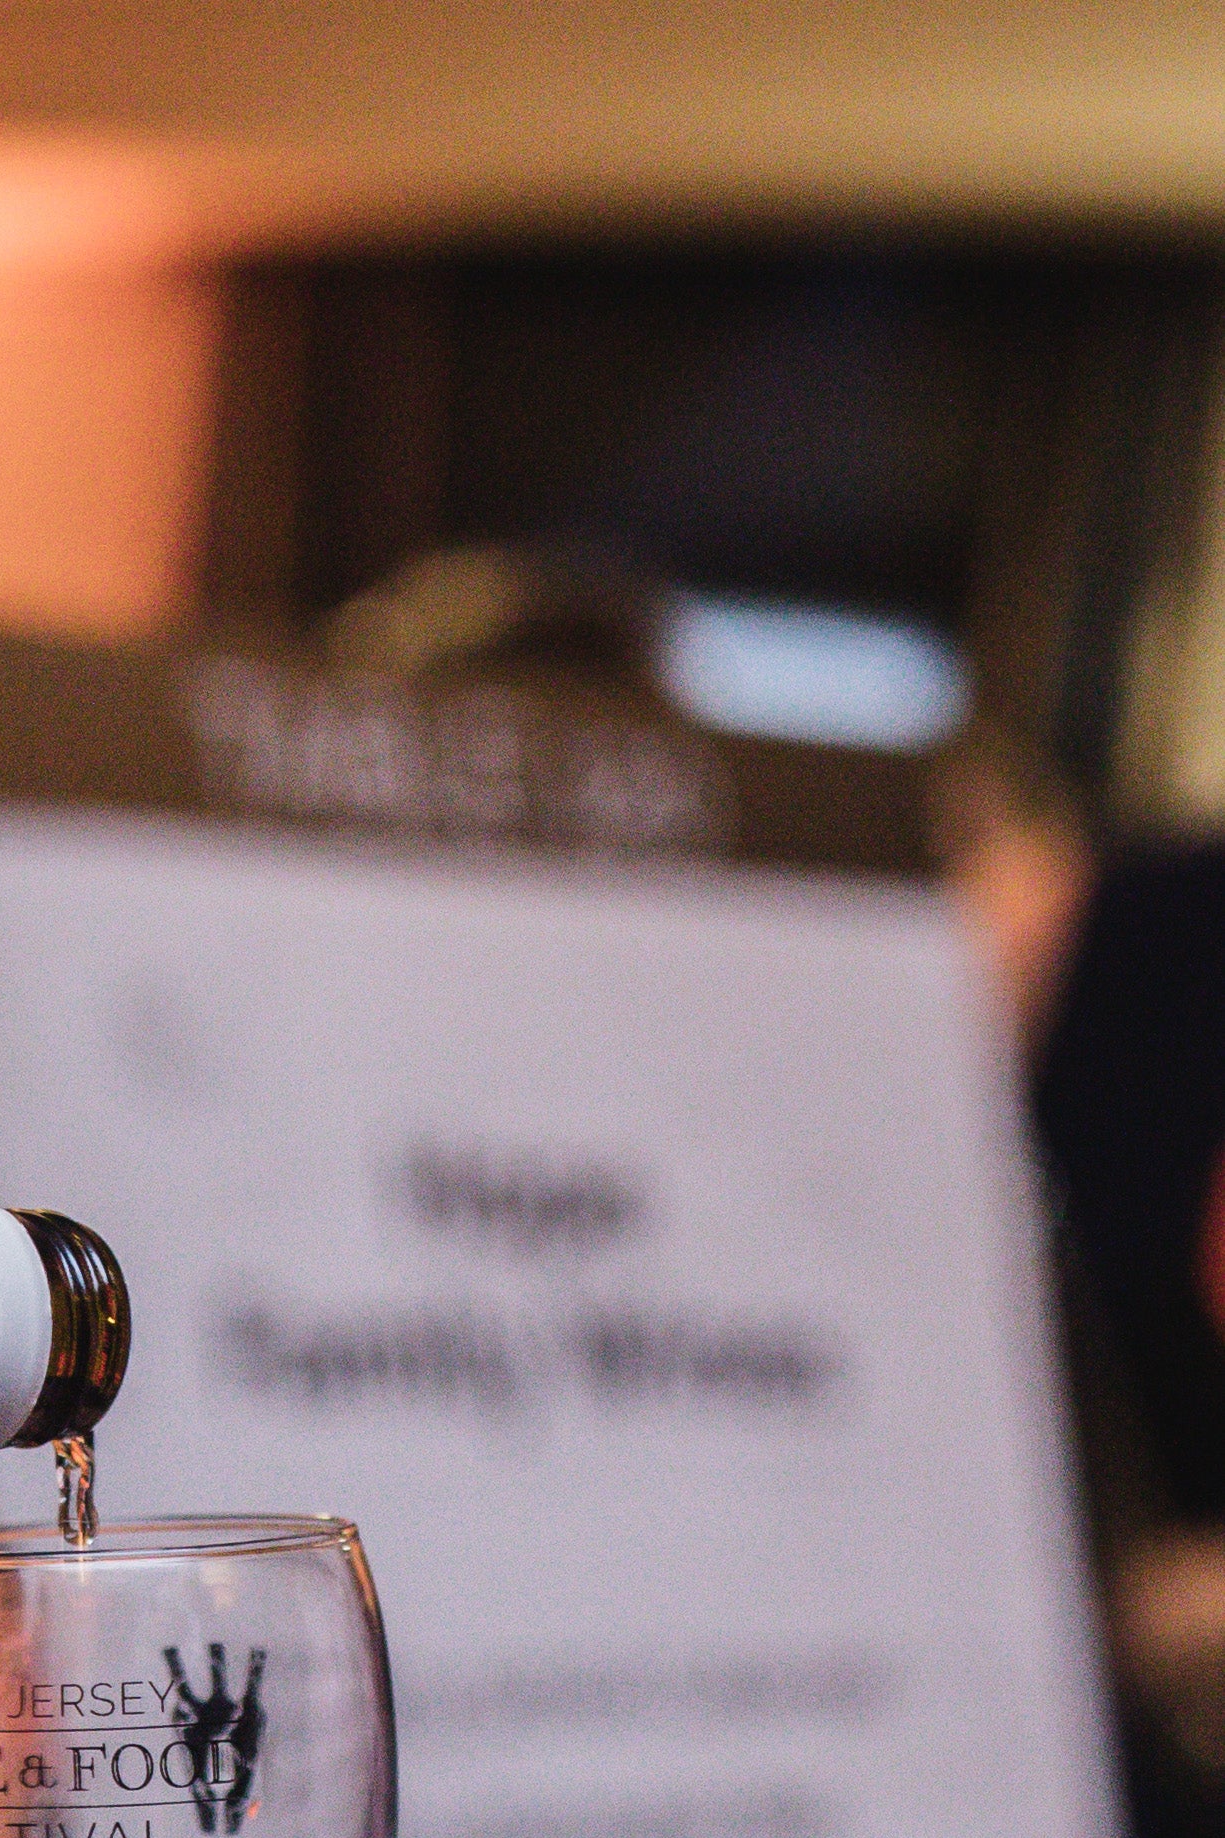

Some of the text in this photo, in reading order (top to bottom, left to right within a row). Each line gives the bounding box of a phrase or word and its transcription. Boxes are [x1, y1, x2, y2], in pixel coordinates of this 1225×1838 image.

[7, 1679, 175, 1719] JERSEY
[18, 1753, 56, 1790] &
[65, 1737, 246, 1792] FOOD
